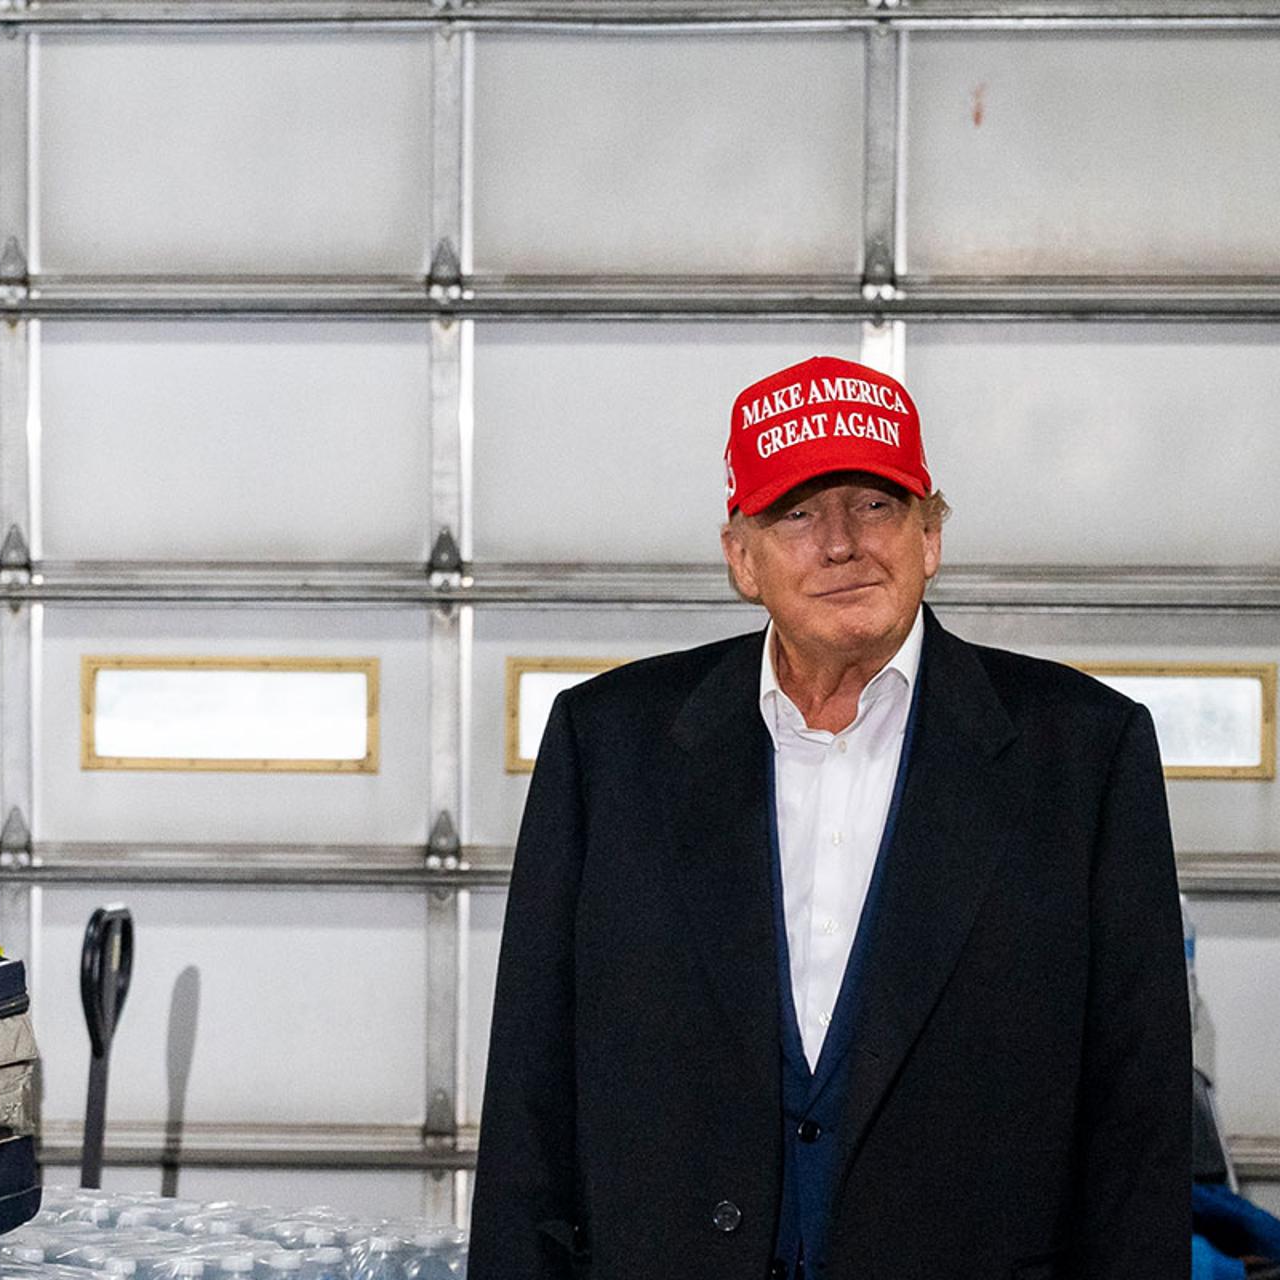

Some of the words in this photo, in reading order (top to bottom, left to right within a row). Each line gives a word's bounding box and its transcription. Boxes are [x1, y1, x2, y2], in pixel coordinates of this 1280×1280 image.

[741, 382, 804, 430] MAKE
[807, 377, 909, 415] AMERICA
[756, 413, 829, 459] GREAT
[833, 412, 901, 448] AGAIN
